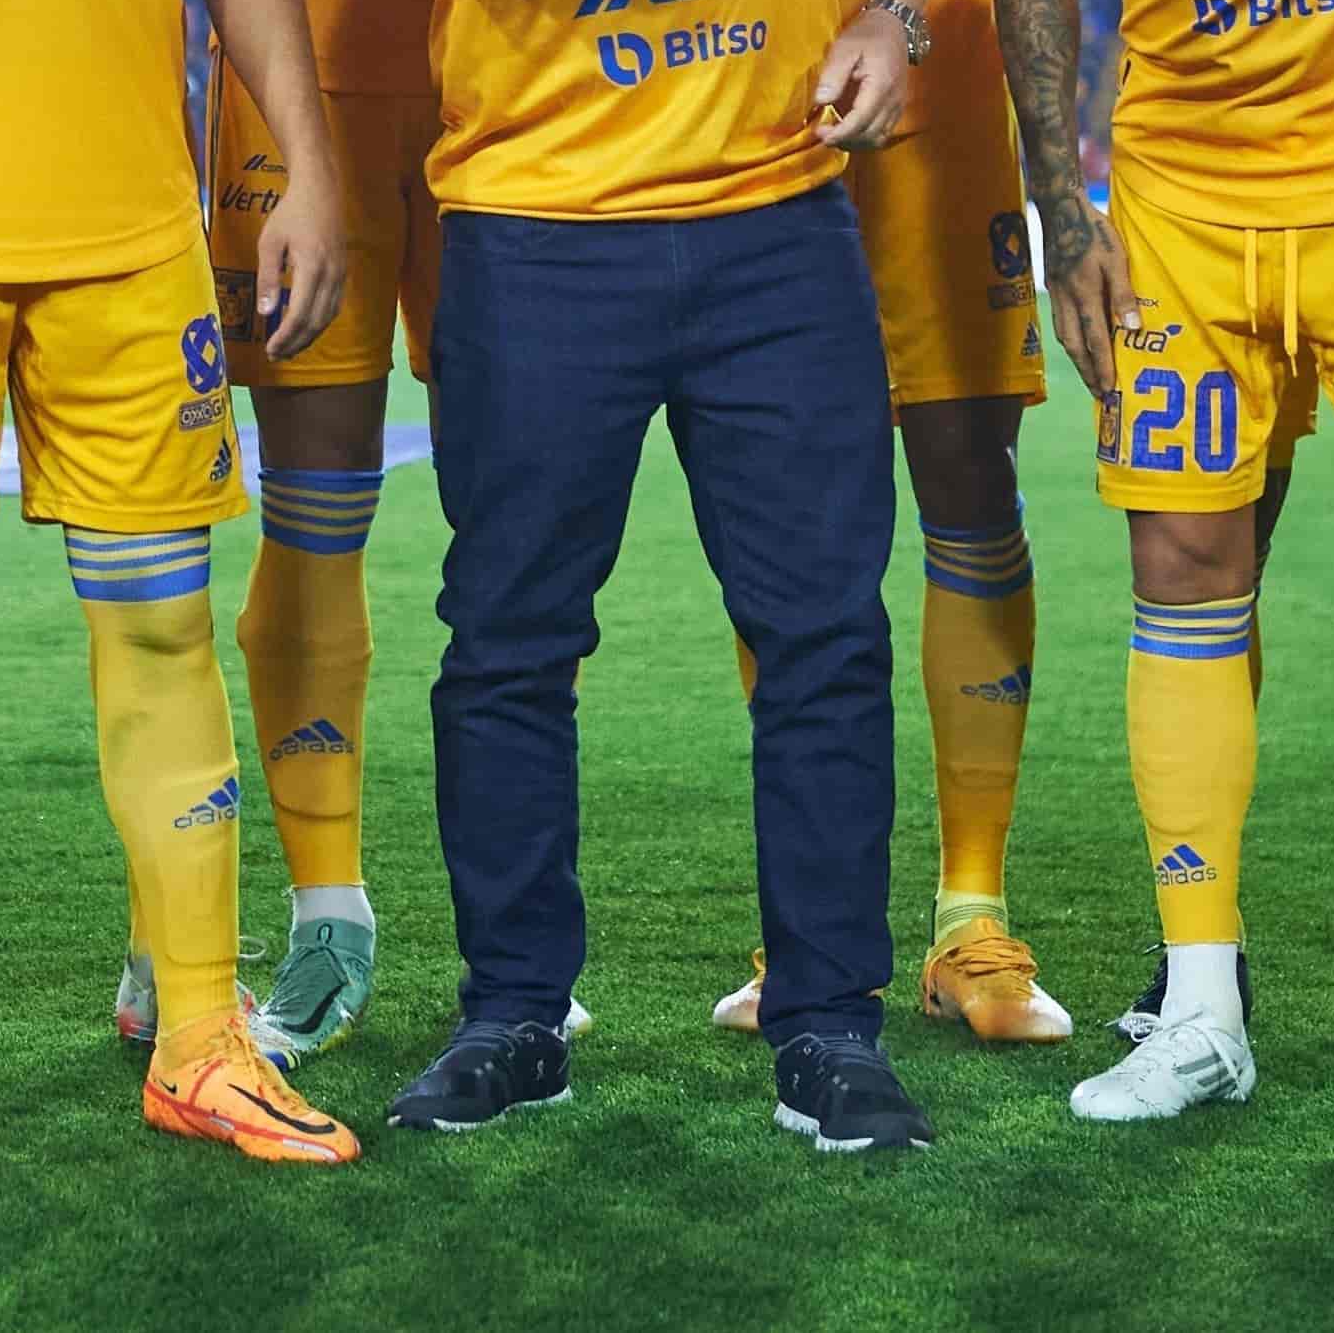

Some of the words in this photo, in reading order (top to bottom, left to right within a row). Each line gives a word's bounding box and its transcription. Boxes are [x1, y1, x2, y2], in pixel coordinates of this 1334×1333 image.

[664, 20, 767, 68] Bitso
[219, 181, 282, 215] Vert
[1131, 368, 1238, 474] 20
[174, 806, 239, 831] adid
